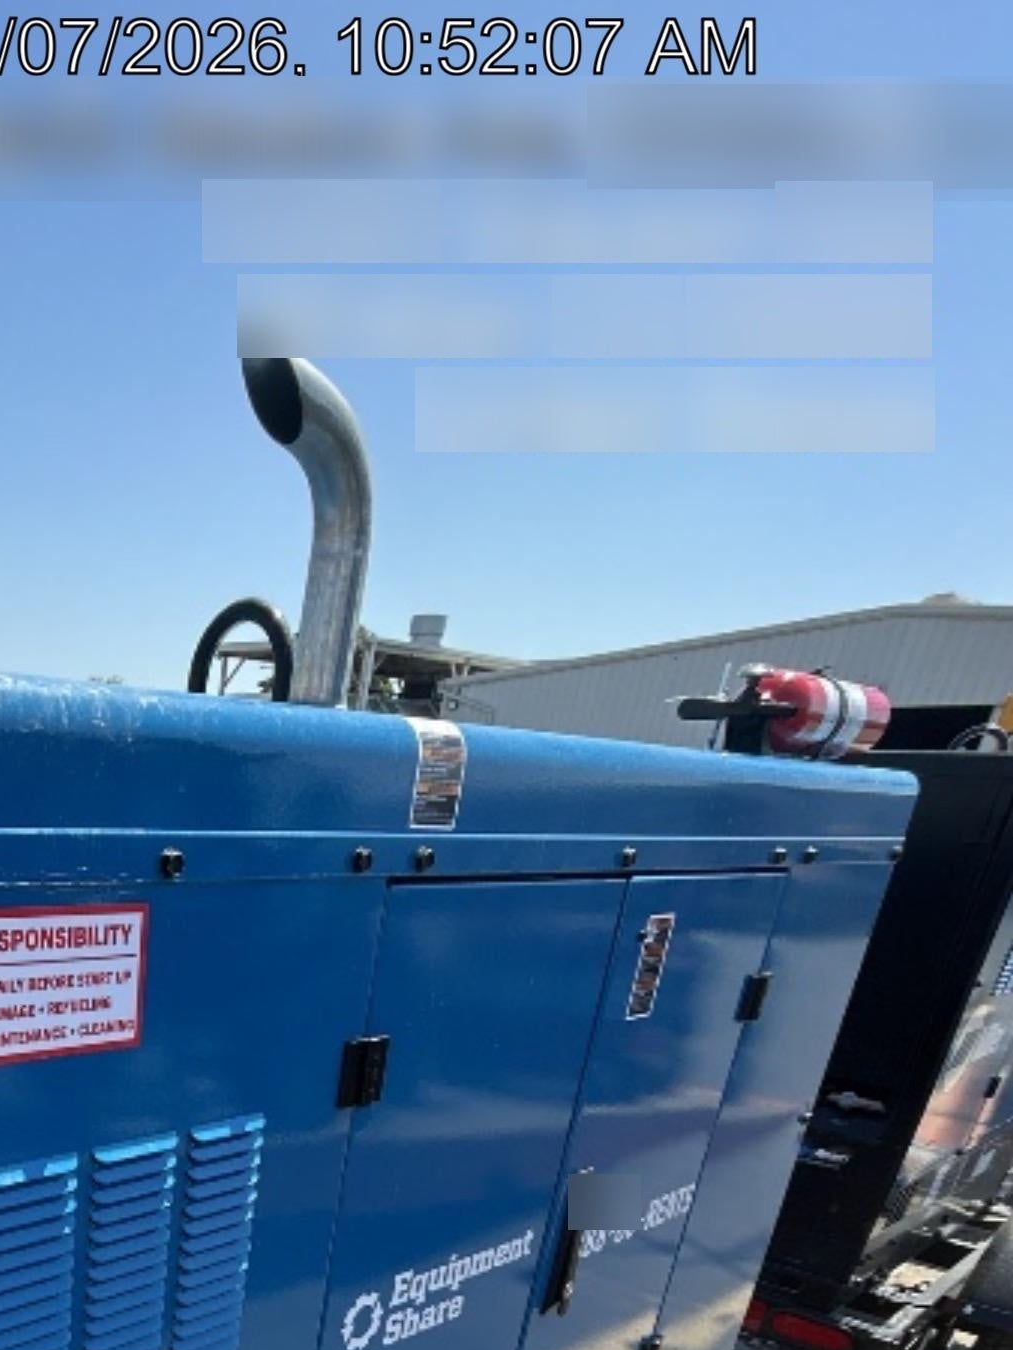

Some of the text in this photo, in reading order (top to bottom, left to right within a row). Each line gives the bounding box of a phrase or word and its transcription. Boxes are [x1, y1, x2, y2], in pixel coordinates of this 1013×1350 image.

[28, 973, 75, 991] BEFORE
[77, 971, 113, 988] START
[115, 970, 132, 984] UP
[77, 1019, 136, 1037] CLEANING
[389, 1229, 535, 1306] Equipment
[382, 1294, 465, 1346] Share
